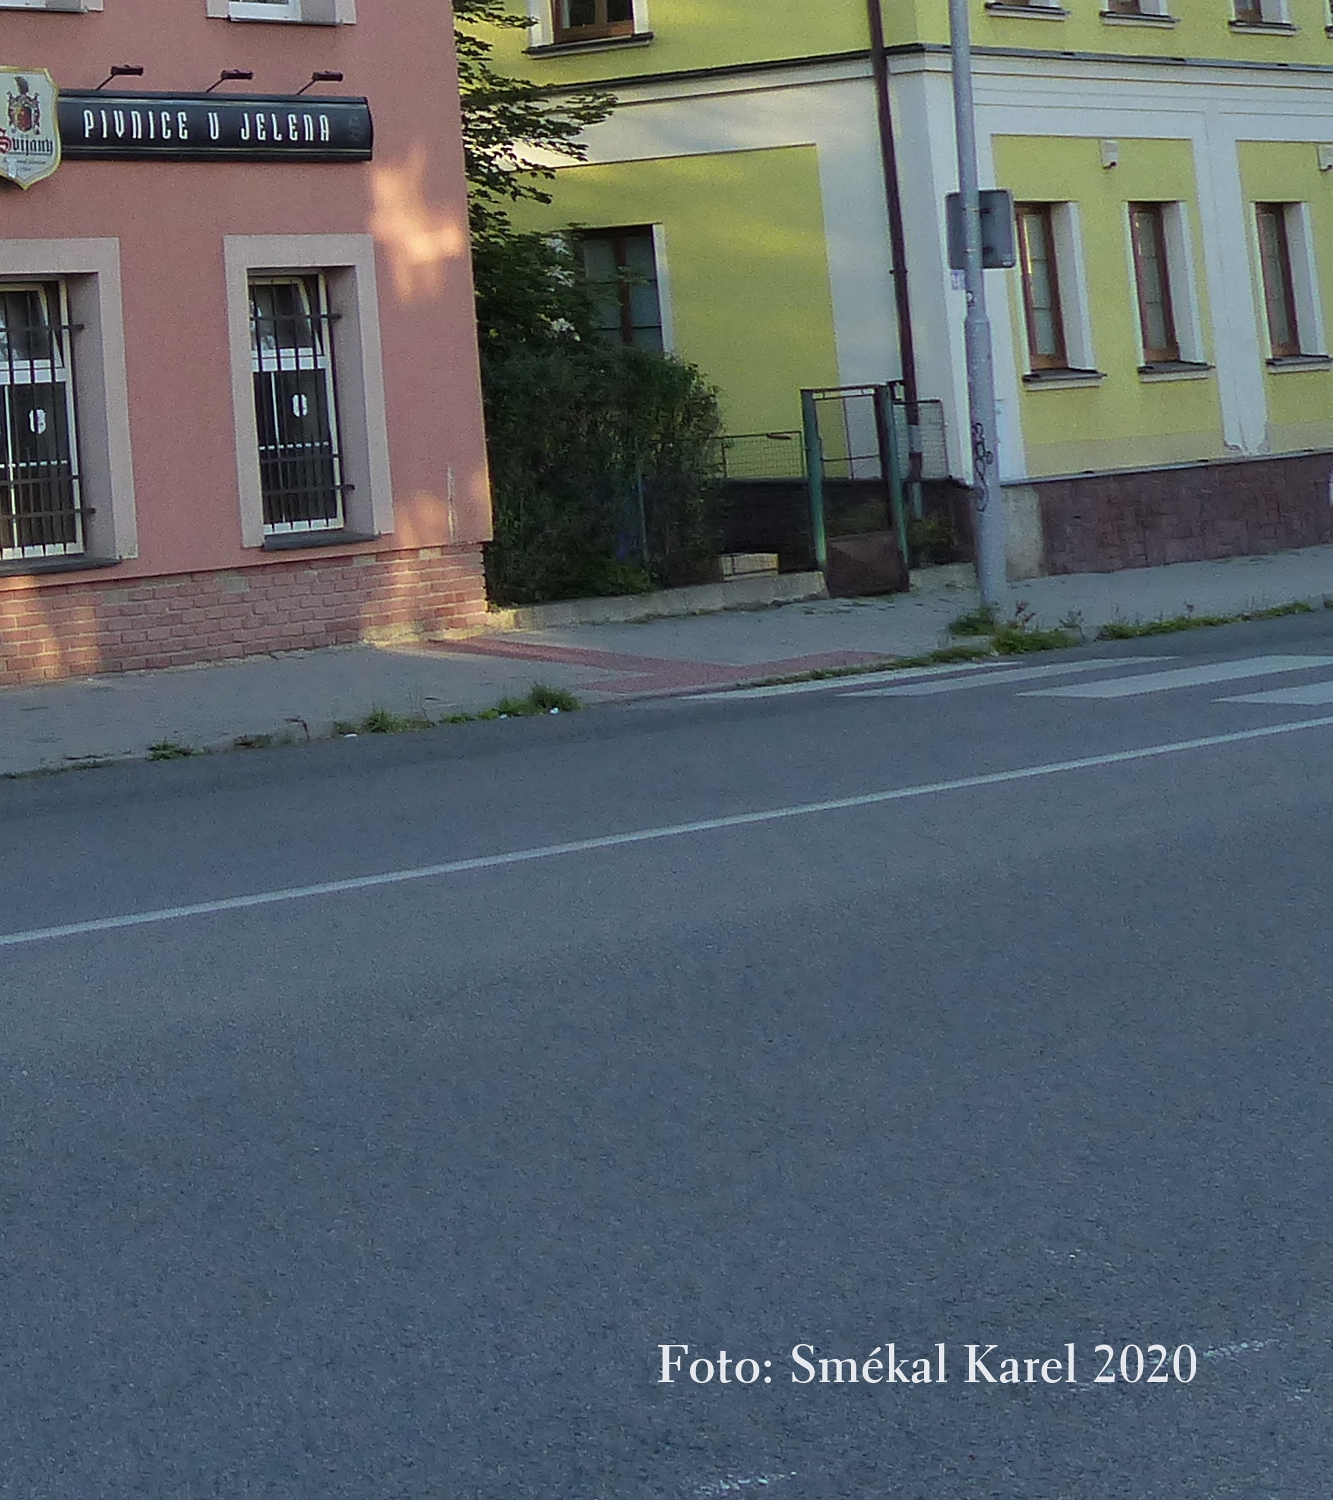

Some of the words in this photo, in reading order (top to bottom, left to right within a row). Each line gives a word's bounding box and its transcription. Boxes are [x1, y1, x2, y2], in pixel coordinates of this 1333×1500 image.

[83, 108, 188, 140] PIVNICE
[208, 111, 221, 141] U
[241, 112, 331, 142] JELENA
